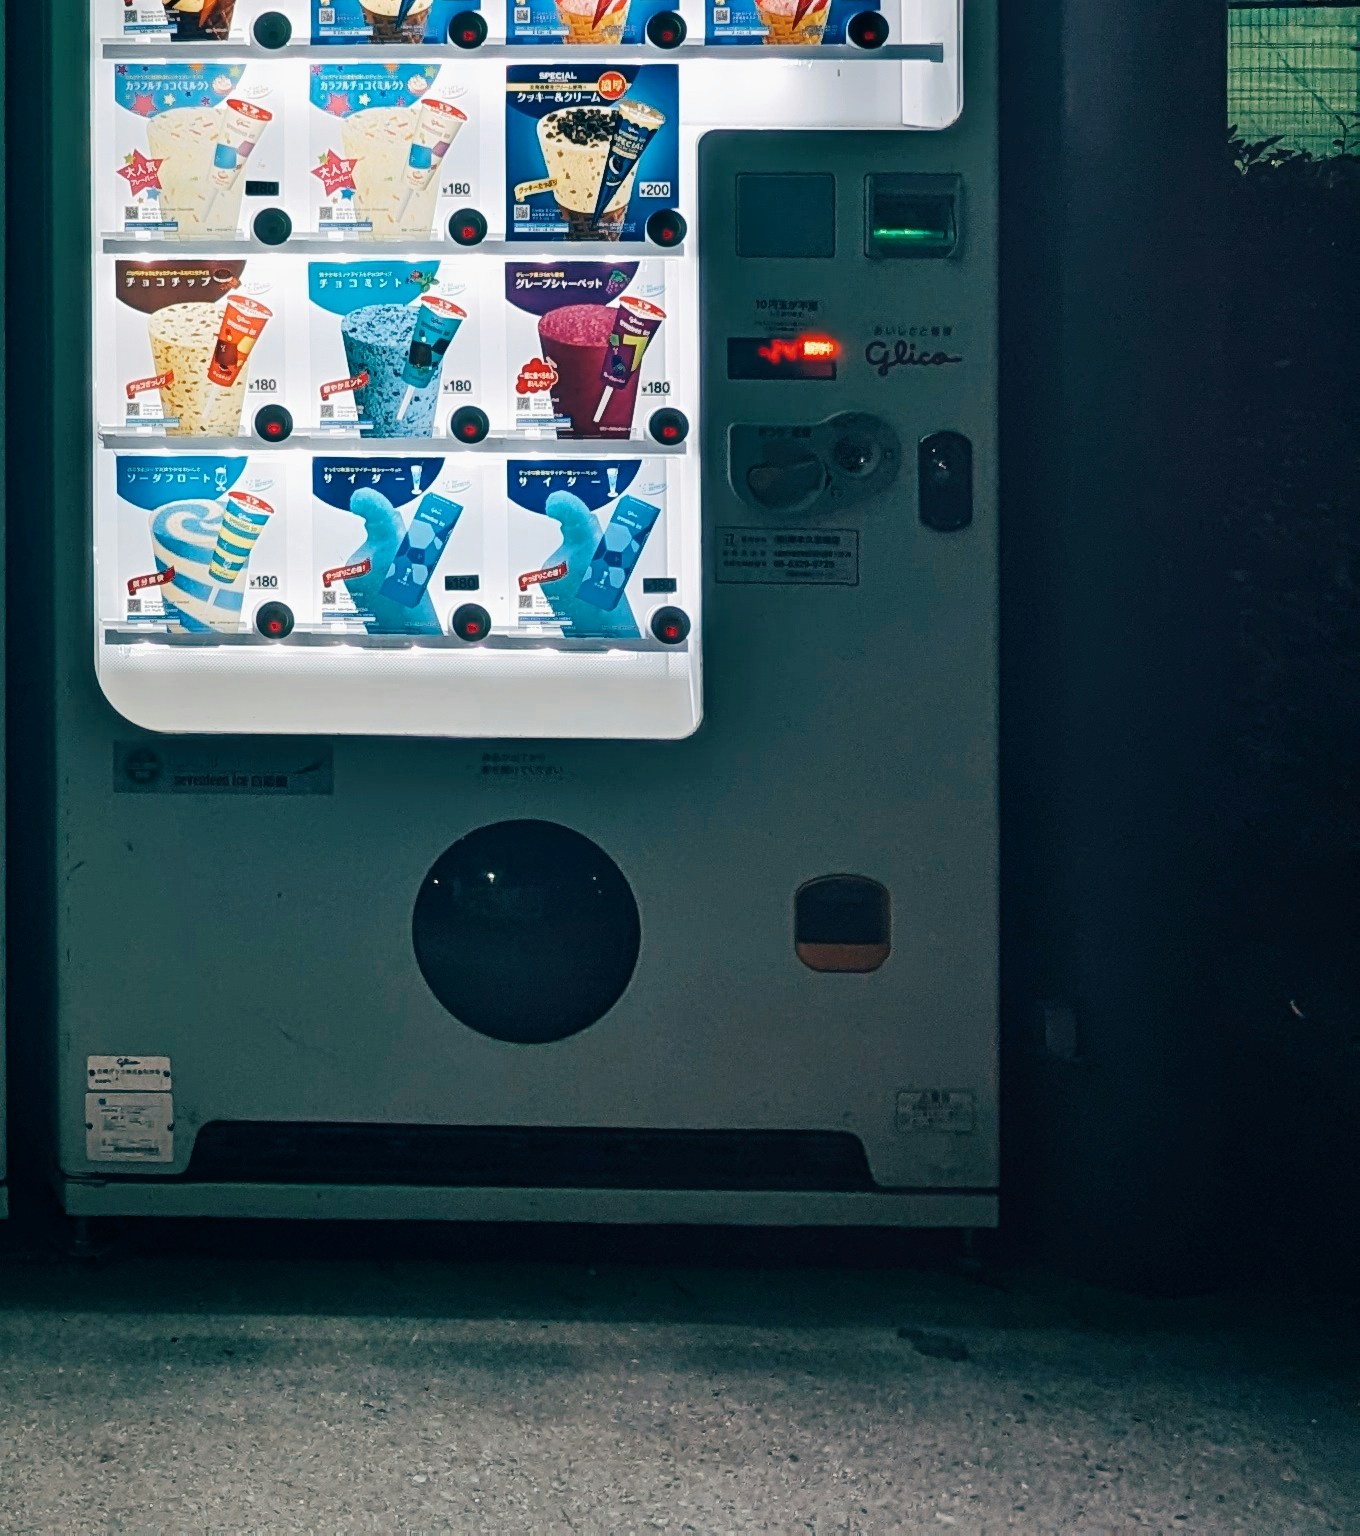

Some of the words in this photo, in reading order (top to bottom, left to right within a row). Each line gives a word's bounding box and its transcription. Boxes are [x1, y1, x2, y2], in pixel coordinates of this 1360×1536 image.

[538, 72, 577, 80] SPECIAL
[516, 91, 600, 104] クッキー&クリーム
[124, 163, 158, 178] 大人気
[318, 163, 352, 178] 大人気
[125, 277, 211, 289] チョコチップ
[319, 277, 402, 289] チョコミント
[515, 277, 604, 290] グレープシャーベット
[865, 339, 962, 376] Glico
[126, 473, 211, 484] ソーダフロート
